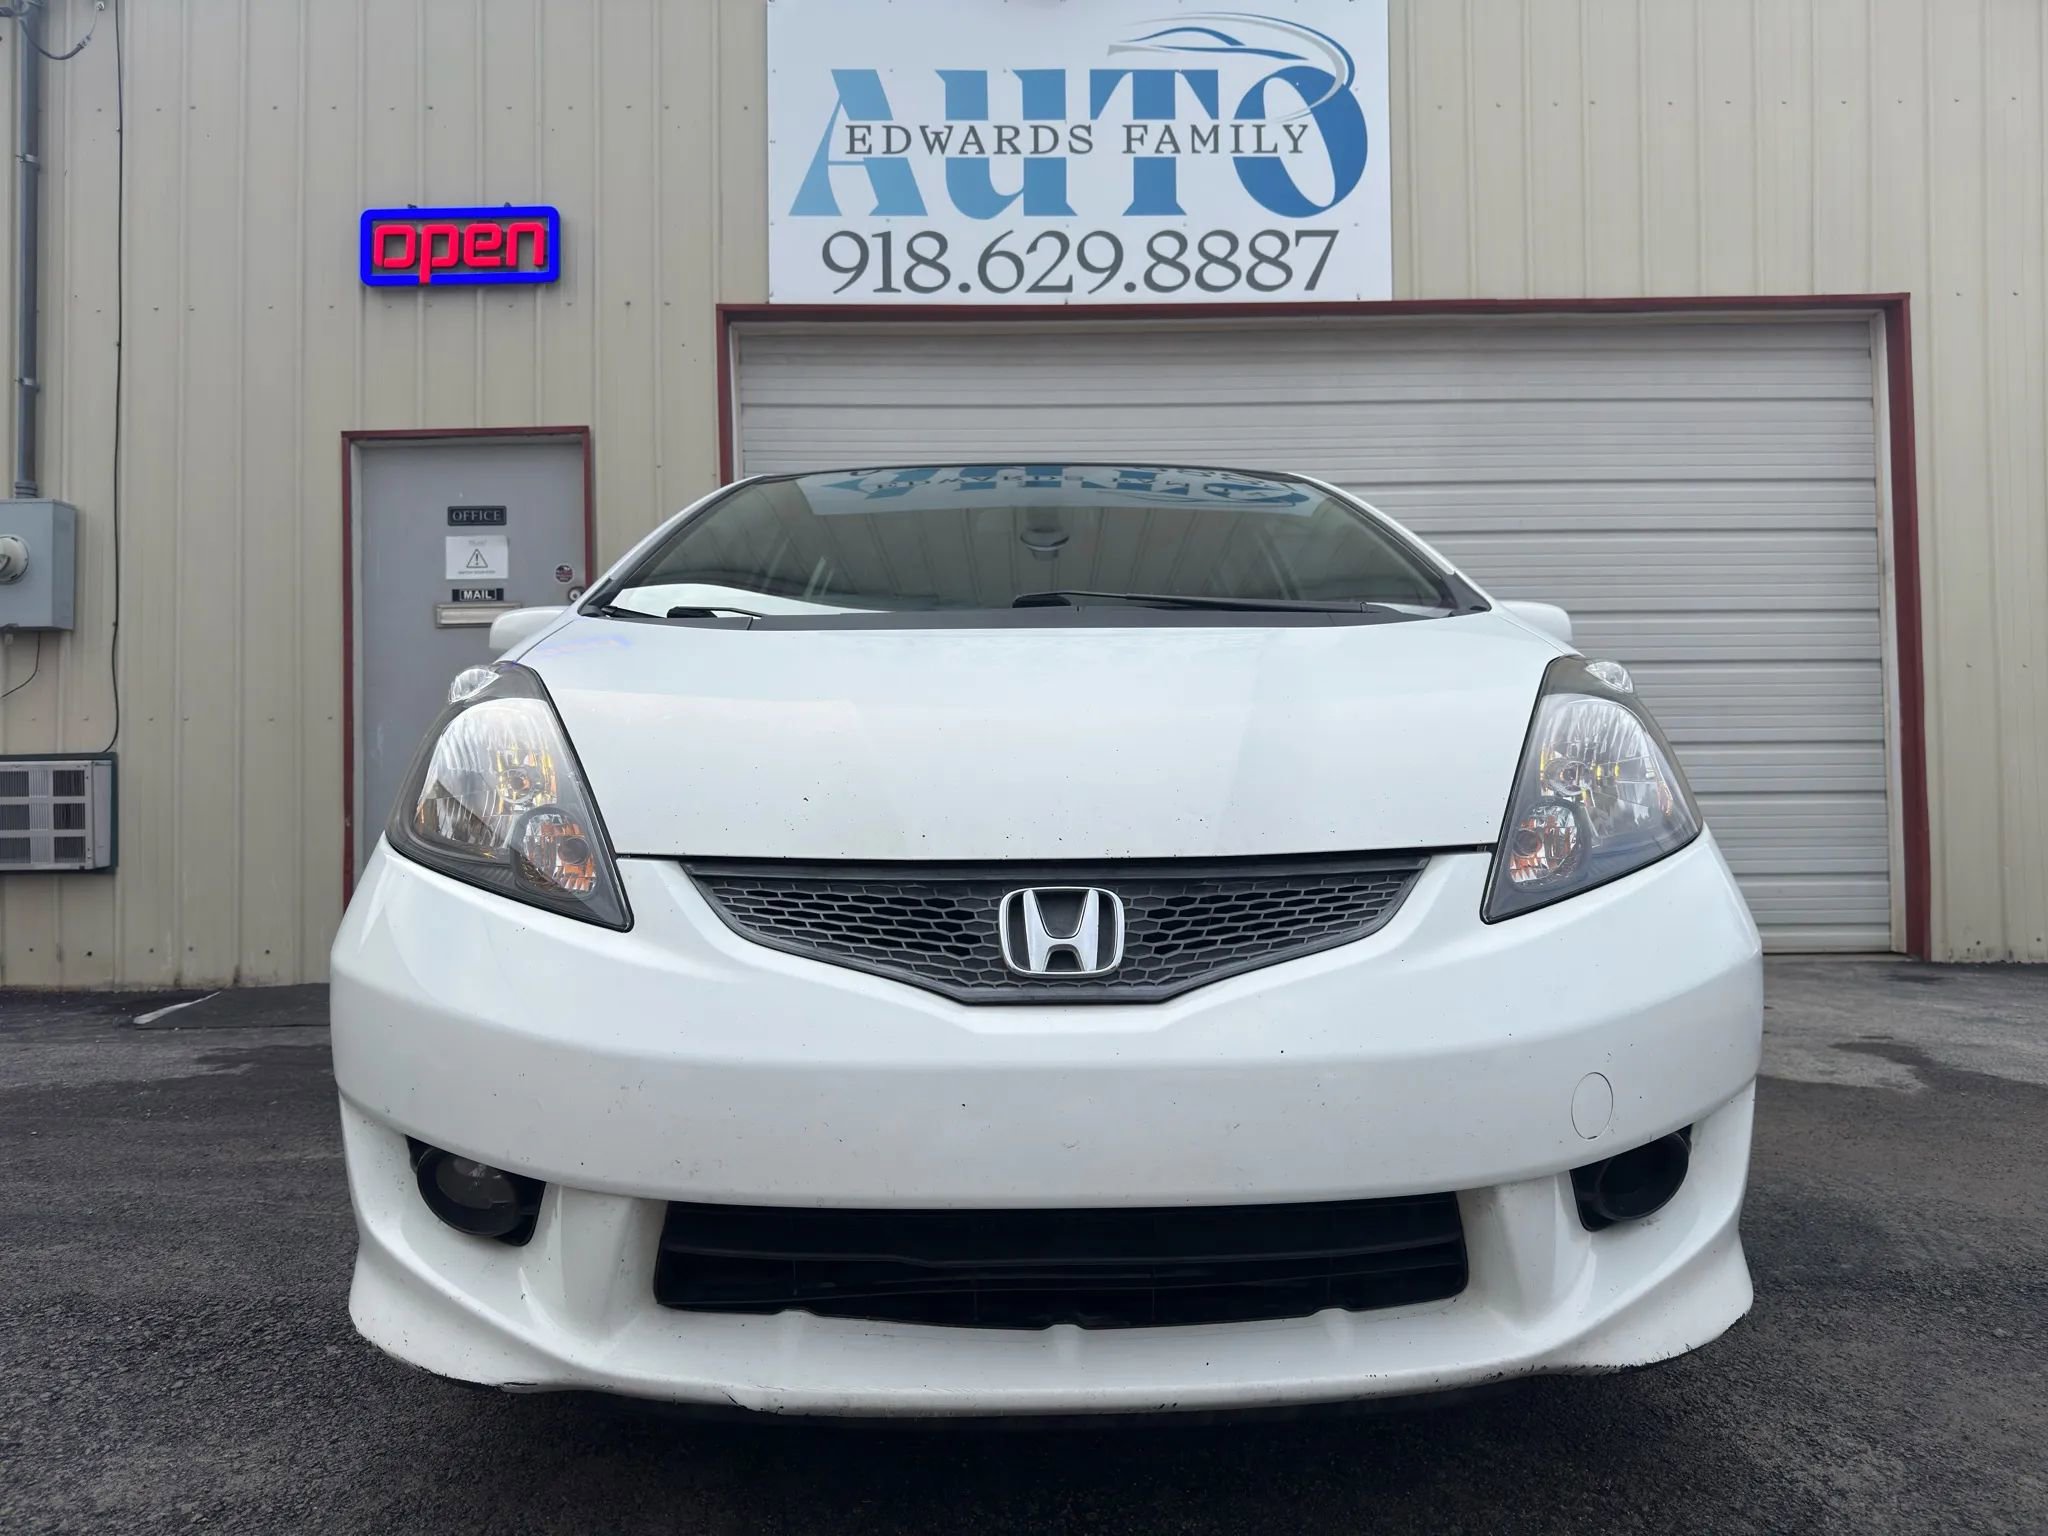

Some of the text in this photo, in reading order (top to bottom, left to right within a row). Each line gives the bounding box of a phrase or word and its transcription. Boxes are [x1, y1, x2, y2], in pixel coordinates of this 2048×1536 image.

[788, 65, 1368, 220] AUTO
[845, 123, 1309, 156] EDWARDS FAMILY
[373, 222, 545, 284] open
[821, 229, 1340, 294] 918.629.8887
[452, 510, 501, 521] OFFICE
[463, 589, 492, 600] MAIL
